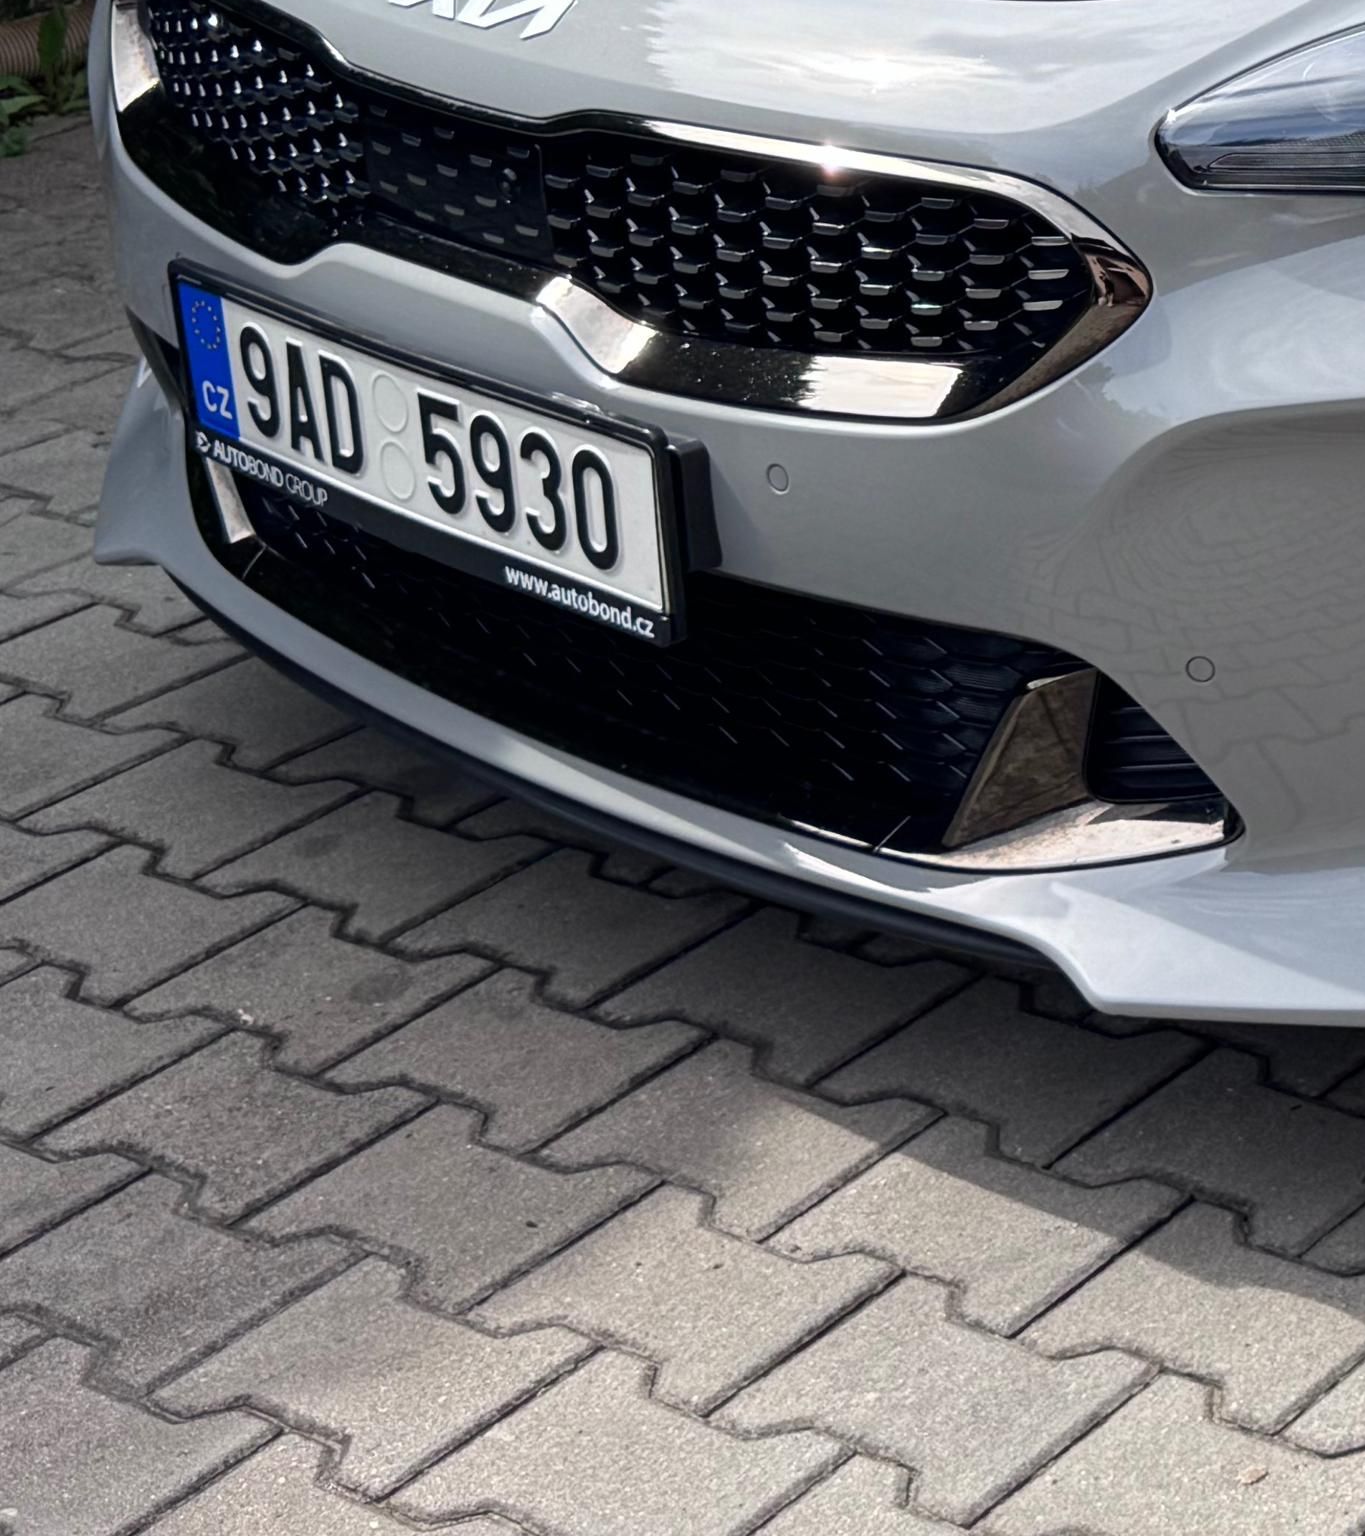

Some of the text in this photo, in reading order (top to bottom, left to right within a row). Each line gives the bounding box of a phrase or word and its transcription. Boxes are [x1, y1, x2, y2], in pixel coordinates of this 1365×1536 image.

[202, 380, 232, 419] CZ
[213, 439, 328, 506] AUTOBOND GROUP
[240, 324, 619, 570] 9AD 5930
[505, 565, 655, 638] www.autobond.cz
